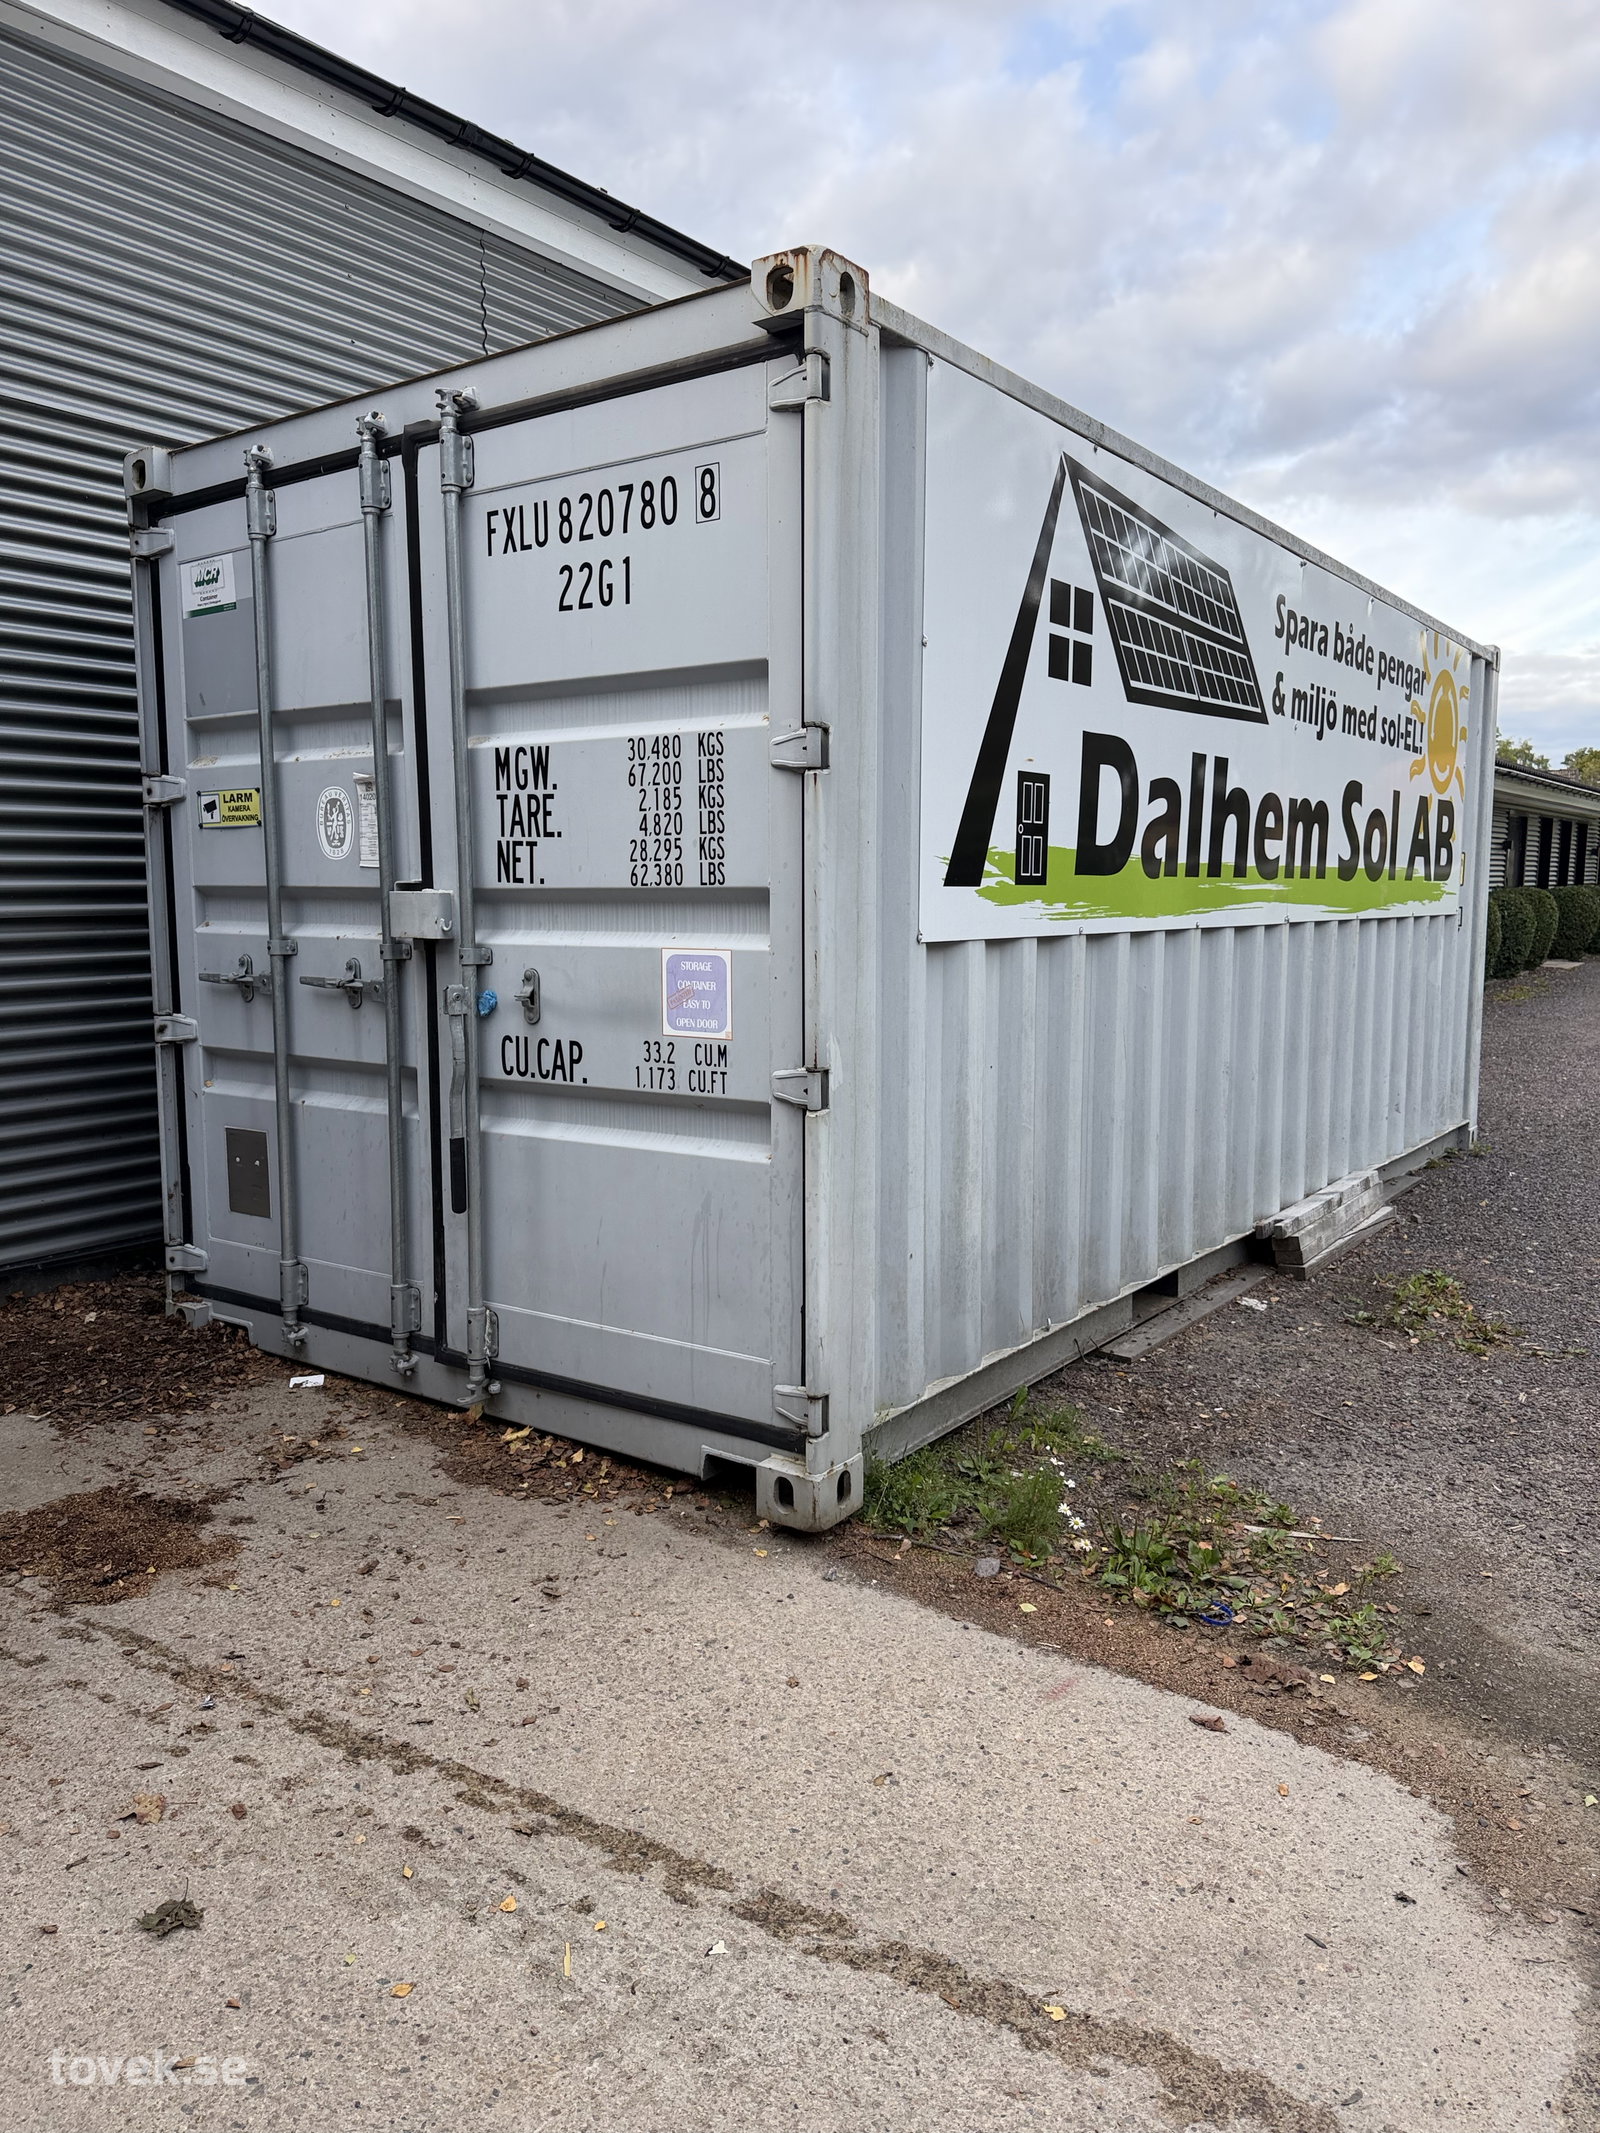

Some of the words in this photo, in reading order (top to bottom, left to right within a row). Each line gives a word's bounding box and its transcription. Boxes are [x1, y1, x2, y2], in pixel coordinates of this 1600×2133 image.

[486, 499, 549, 557] FXLU
[558, 475, 678, 544] 820780
[700, 467, 716, 519] 8
[558, 555, 631, 612] 22G1
[1274, 593, 1329, 657] Spara
[1333, 621, 1375, 676] både
[1377, 650, 1427, 702] pengar
[1271, 671, 1286, 717] &
[1290, 682, 1337, 741] miljö
[1341, 703, 1378, 742] med
[1380, 713, 1425, 755] sol-EL!
[627, 734, 681, 762] 30,480
[697, 731, 725, 757] KGS
[494, 745, 558, 791] MGW.
[628, 760, 682, 787] 67,200
[698, 758, 725, 783] LBS
[222, 792, 253, 804] LARM
[227, 804, 251, 813] KAMERA
[638, 786, 682, 812] 2,185
[698, 784, 725, 809] KGS
[1074, 729, 1330, 881] Dalhem
[1337, 779, 1401, 882] Sol
[1404, 795, 1455, 882] AB
[496, 793, 562, 838] TARE.
[639, 812, 683, 837] 4,820
[699, 809, 725, 835] LBS
[497, 840, 545, 885] NET.
[629, 837, 682, 863] 28,295
[699, 836, 726, 861] KGS
[630, 863, 683, 887] 62,380
[699, 861, 726, 886] LBS
[680, 960, 713, 972] STORAGE
[677, 979, 717, 991] CONTAINER
[683, 999, 700, 1009] EASY
[701, 999, 711, 1010] TO
[676, 1017, 696, 1028] OPEN
[697, 1018, 719, 1030] DOOR
[501, 1034, 588, 1084] CU.CAP.
[643, 1040, 675, 1065] 33.2
[694, 1043, 727, 1068] CU.M
[635, 1065, 675, 1090] 1,173
[688, 1069, 727, 1095] CU.FT
